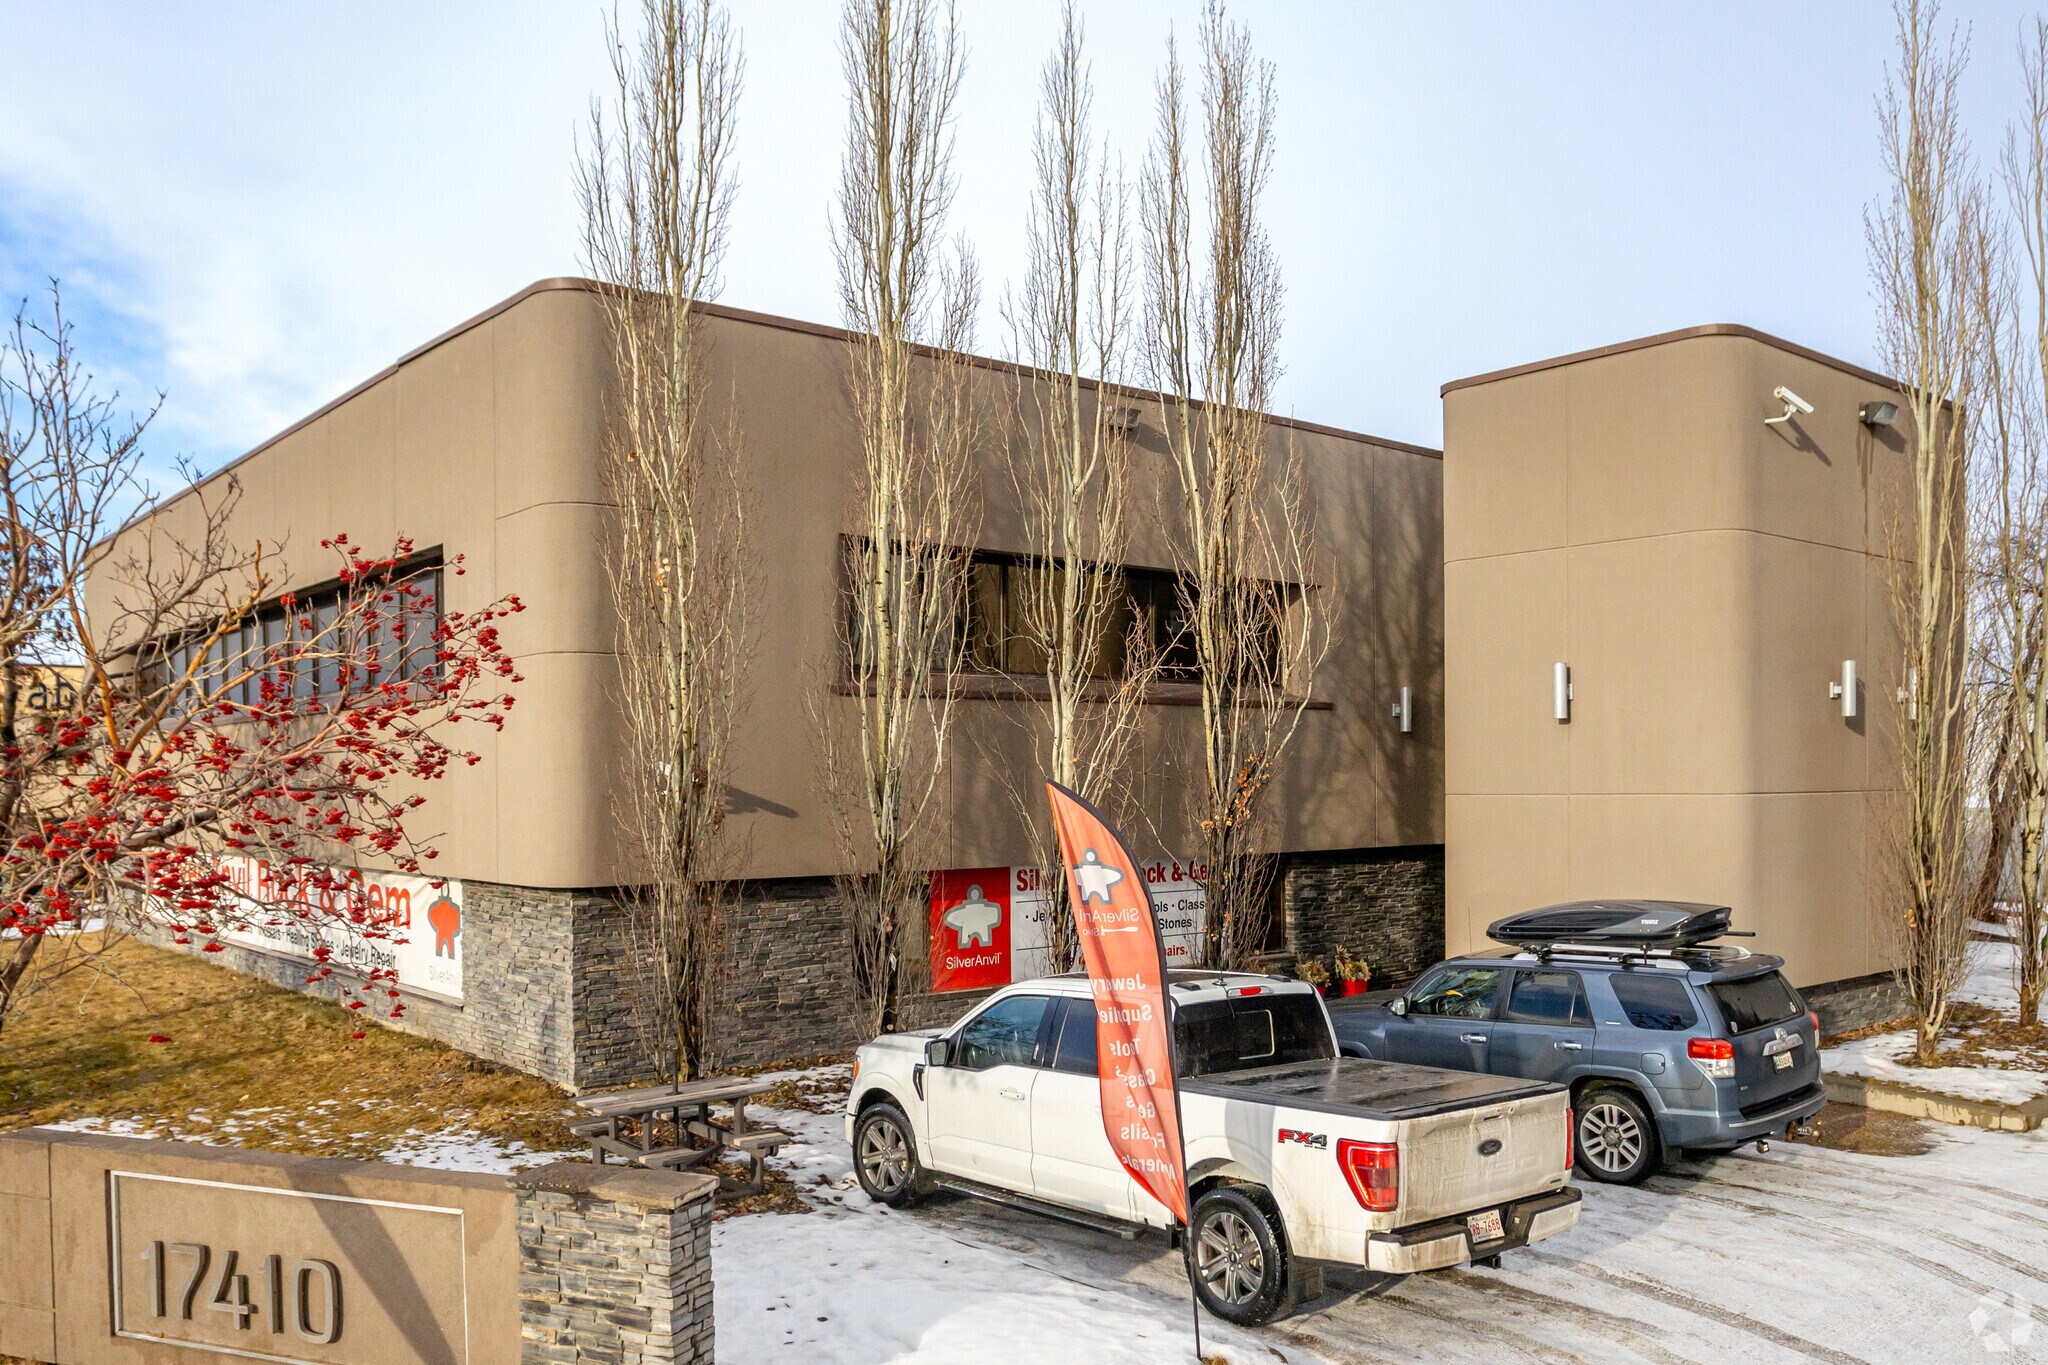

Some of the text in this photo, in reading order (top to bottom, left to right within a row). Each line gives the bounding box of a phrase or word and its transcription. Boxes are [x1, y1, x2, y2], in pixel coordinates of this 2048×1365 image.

[28, 672, 75, 710] ab
[1171, 860, 1184, 882] &
[1188, 860, 1207, 881] Ge
[346, 869, 411, 929] Gem
[1177, 899, 1205, 911] Class
[946, 953, 1001, 970] SilverAnvil
[1278, 1128, 1328, 1147] FX4
[140, 1240, 341, 1344] 17410
